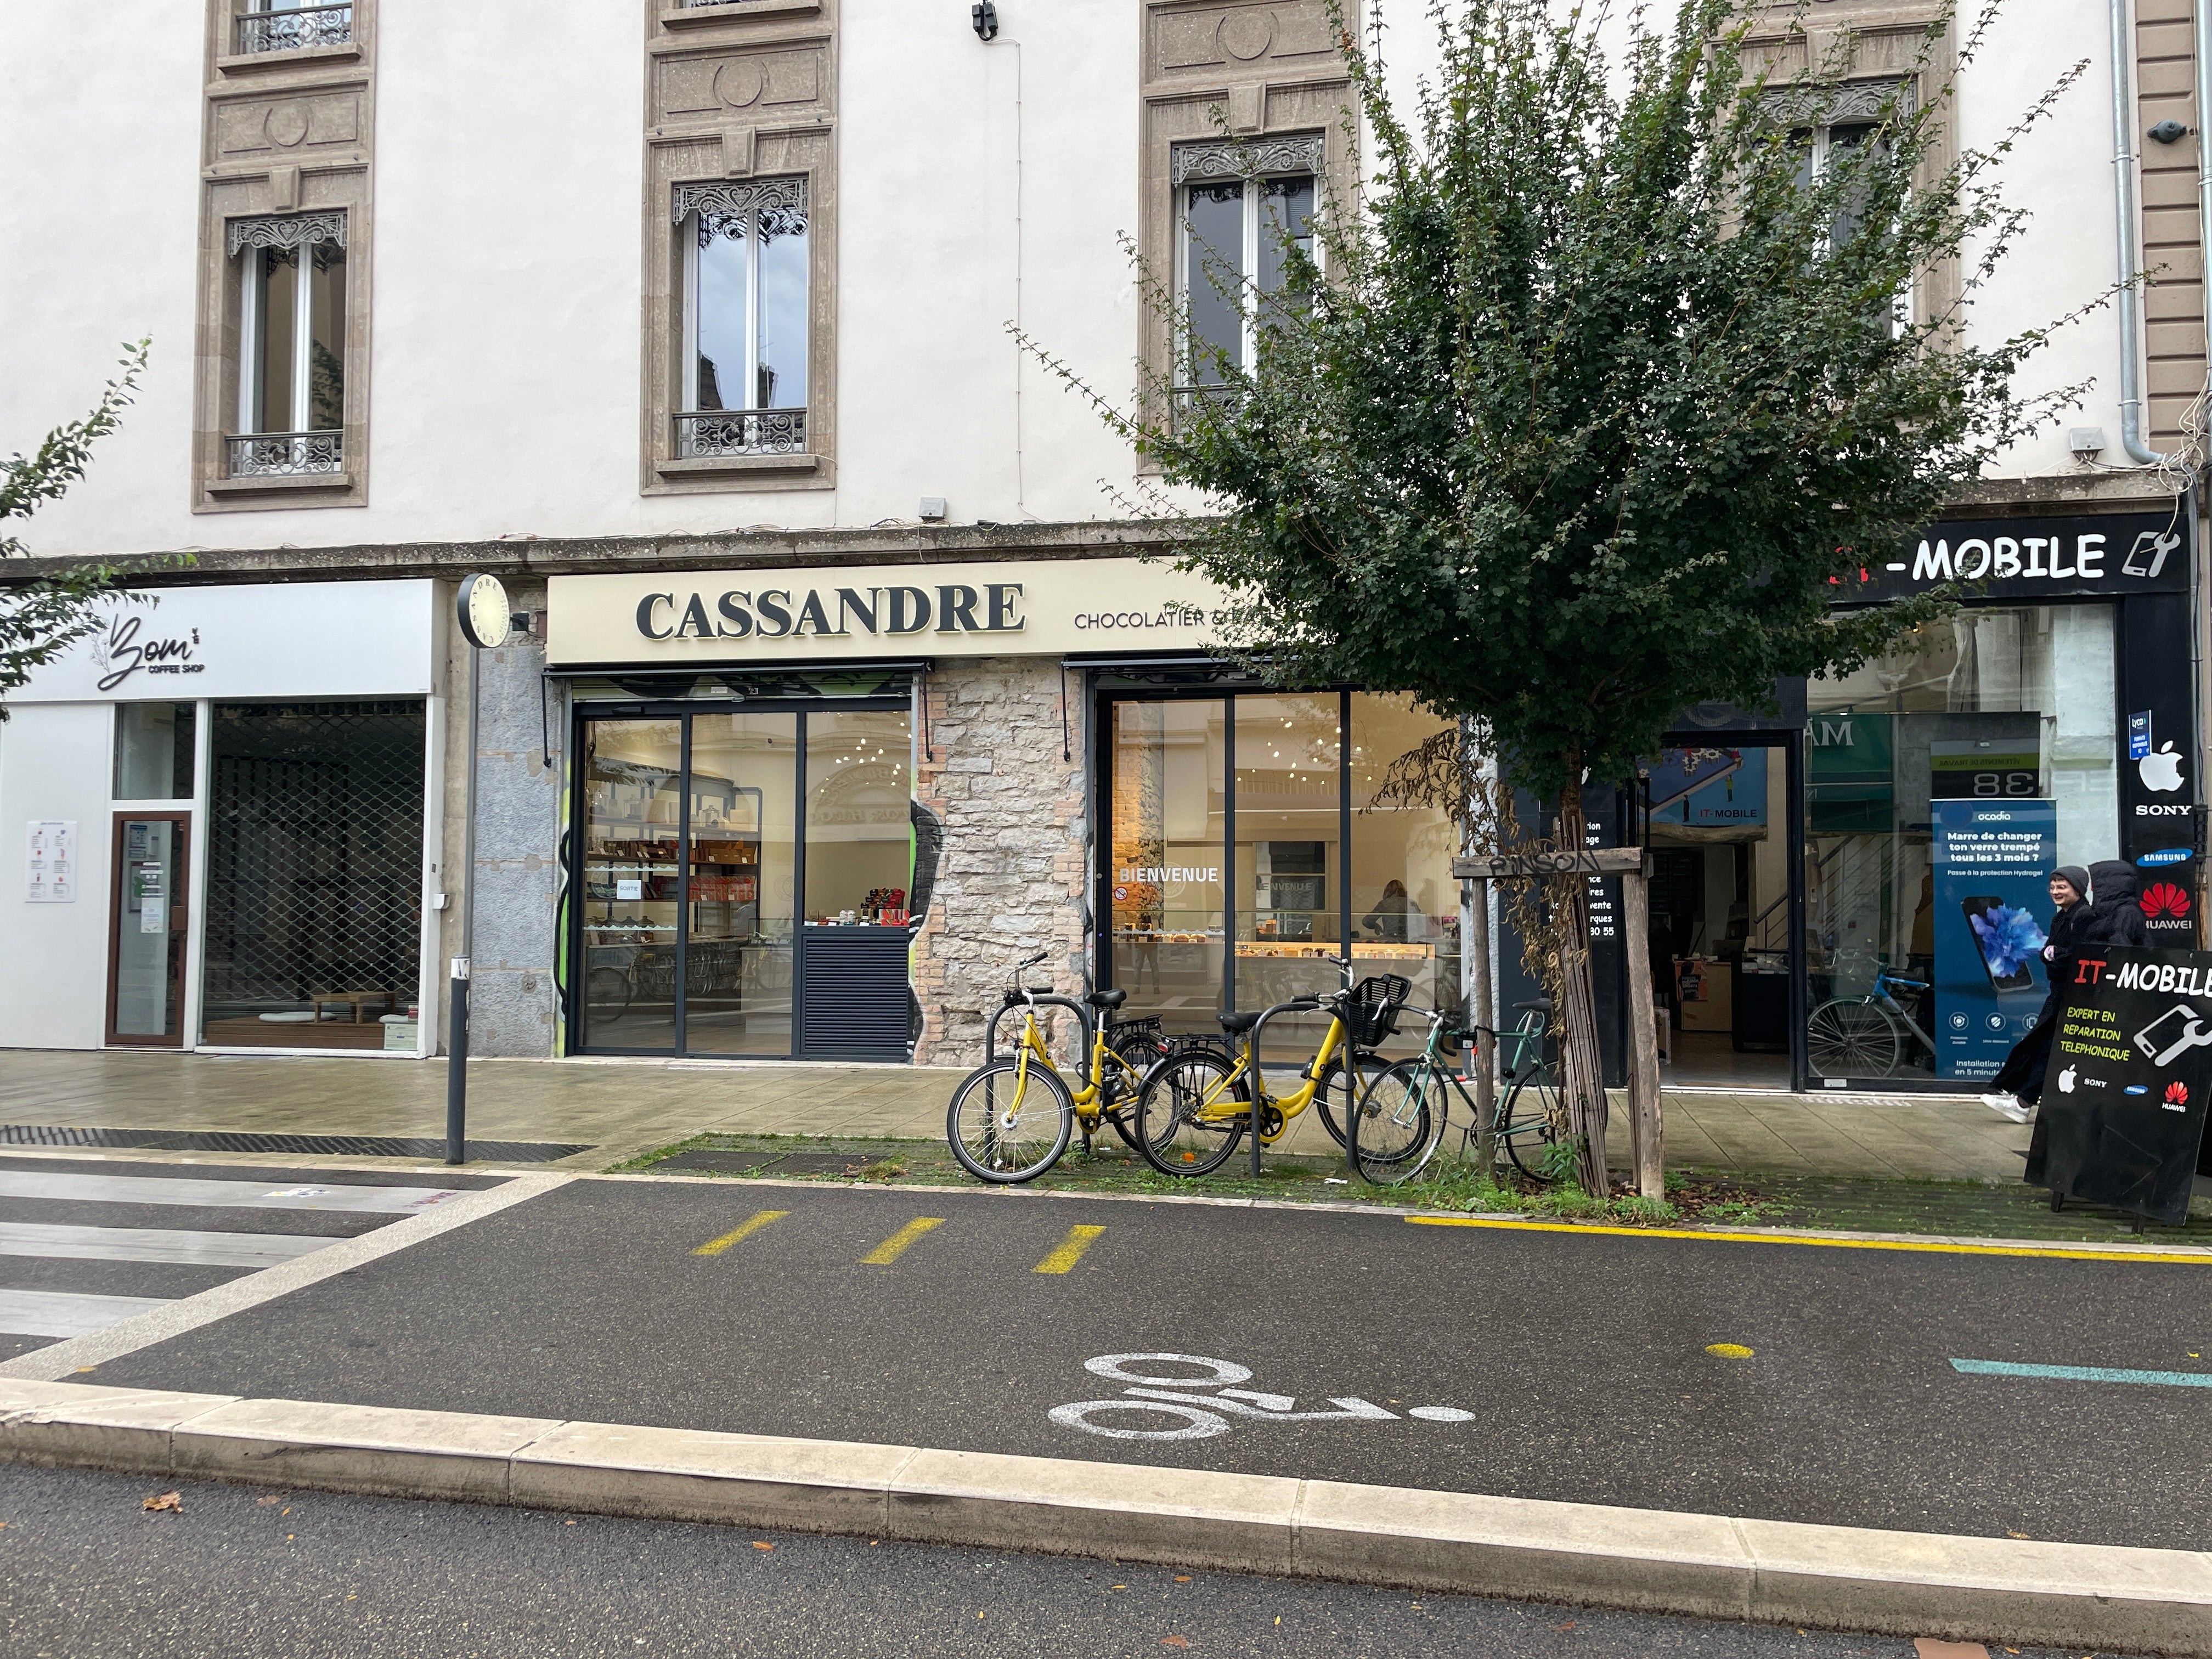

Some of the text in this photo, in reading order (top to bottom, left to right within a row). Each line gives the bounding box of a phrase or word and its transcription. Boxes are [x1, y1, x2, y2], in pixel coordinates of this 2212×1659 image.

[1829, 534, 2106, 583] -MOBILE
[471, 578, 497, 644] CASSANDRE
[636, 583, 1025, 640] CASSANDRE
[1075, 611, 1205, 629] CHOCOLATIER
[148, 664, 205, 674] COFFEE SHOP
[2136, 805, 2192, 816] SONY
[1948, 832, 2042, 842] Marre de changer
[2001, 843, 2040, 852] trempé
[1977, 853, 1992, 861] les
[2004, 853, 2030, 861] mois
[1120, 867, 1218, 882] BIENVENUE
[1590, 916, 1613, 924] rques
[1603, 927, 1615, 936] 55
[2067, 1007, 2116, 1022] EXPERT EN
[2063, 1024, 2121, 1041] REPARATION
[2061, 1041, 2131, 1061] TELEPHONIQUE
[2084, 1078, 2107, 1088] SONY
[2162, 1103, 2186, 1113] HUAWEI
